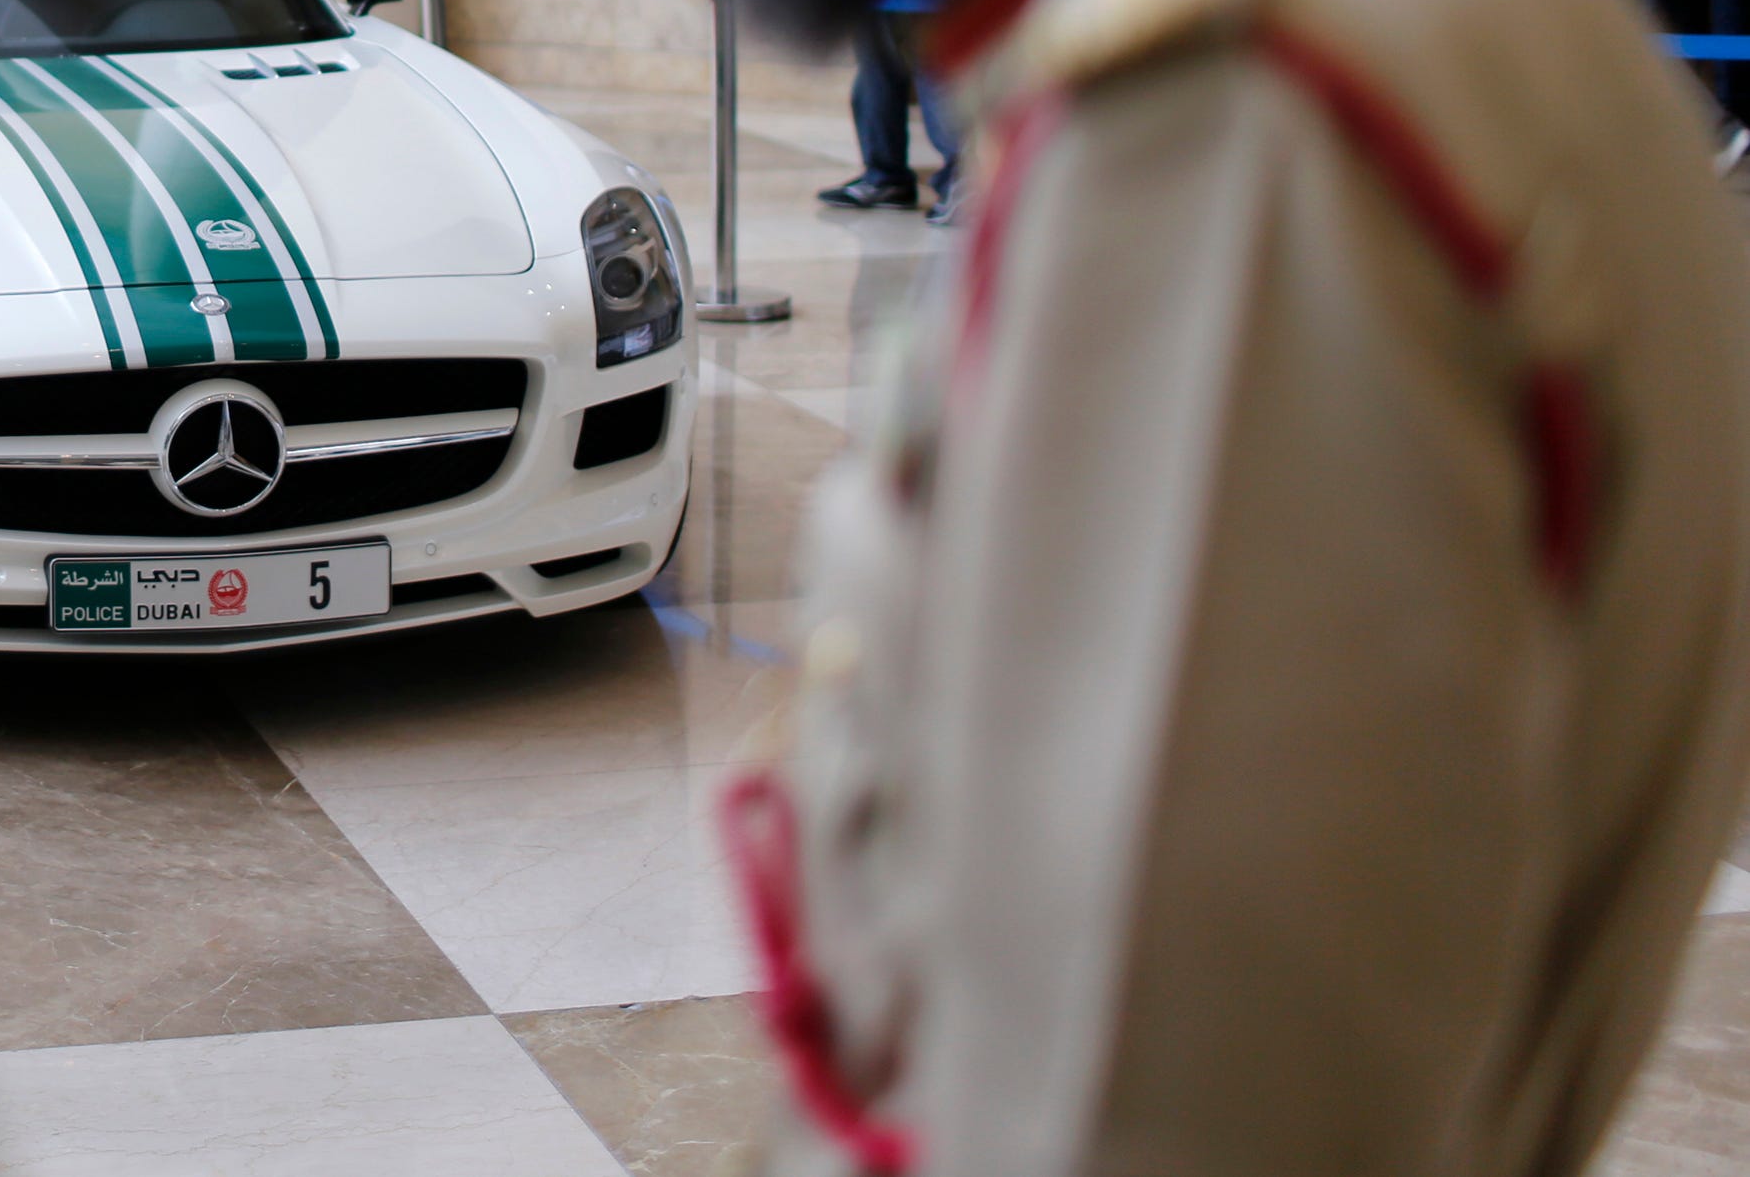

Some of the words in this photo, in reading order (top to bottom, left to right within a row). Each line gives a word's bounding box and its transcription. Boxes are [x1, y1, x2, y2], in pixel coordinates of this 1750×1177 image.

[61, 570, 124, 590] الشرطة
[137, 569, 200, 589] دبي
[309, 560, 331, 610] 5
[61, 606, 124, 622] POLICE
[137, 604, 201, 621] DUBAI
